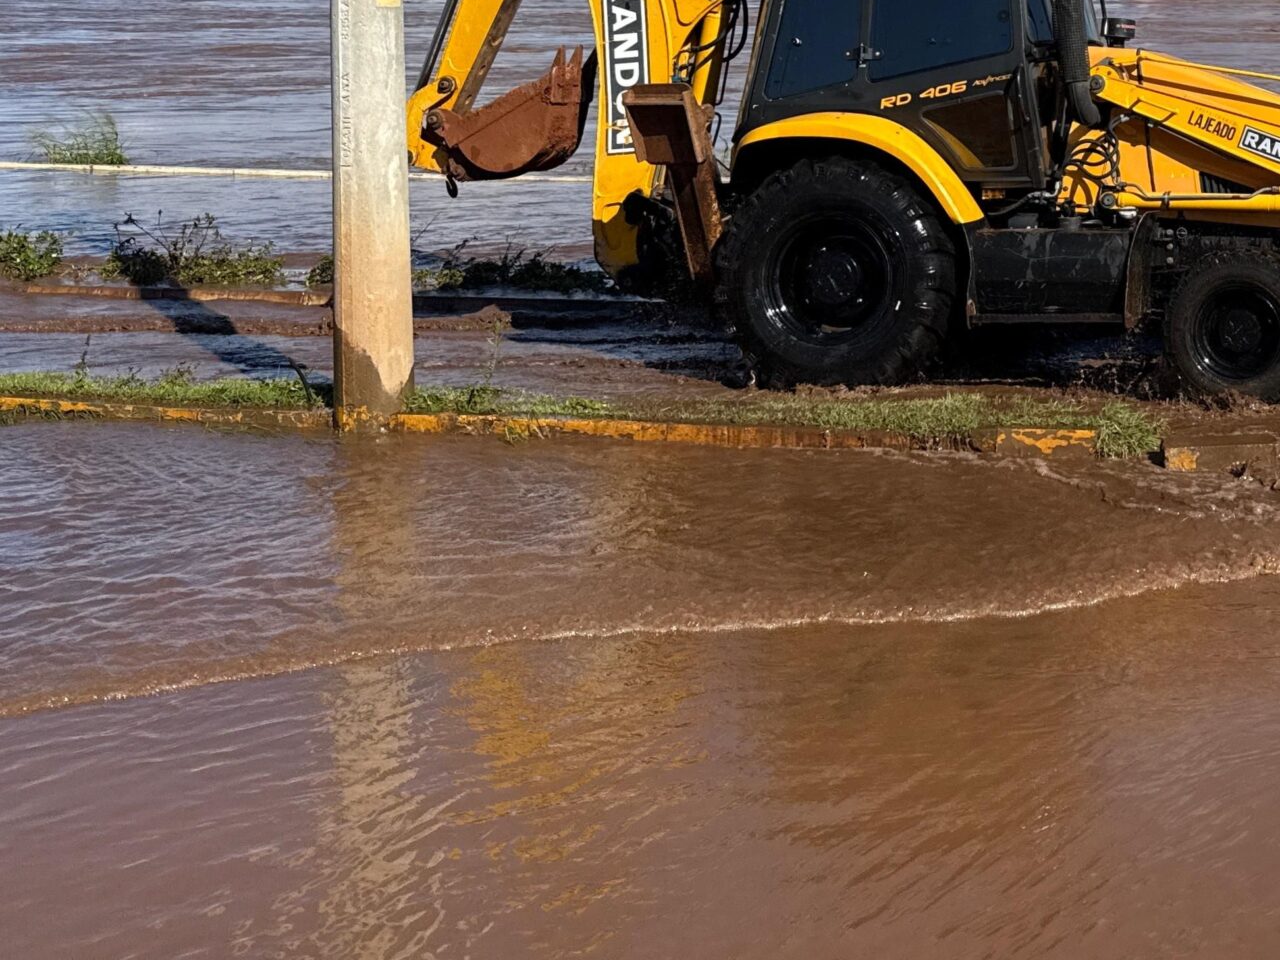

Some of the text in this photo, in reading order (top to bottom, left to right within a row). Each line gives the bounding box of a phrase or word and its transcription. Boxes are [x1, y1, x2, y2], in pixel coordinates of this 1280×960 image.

[880, 93, 912, 110] RD
[919, 80, 968, 99] 406
[1187, 110, 1237, 141] LAJEADO
